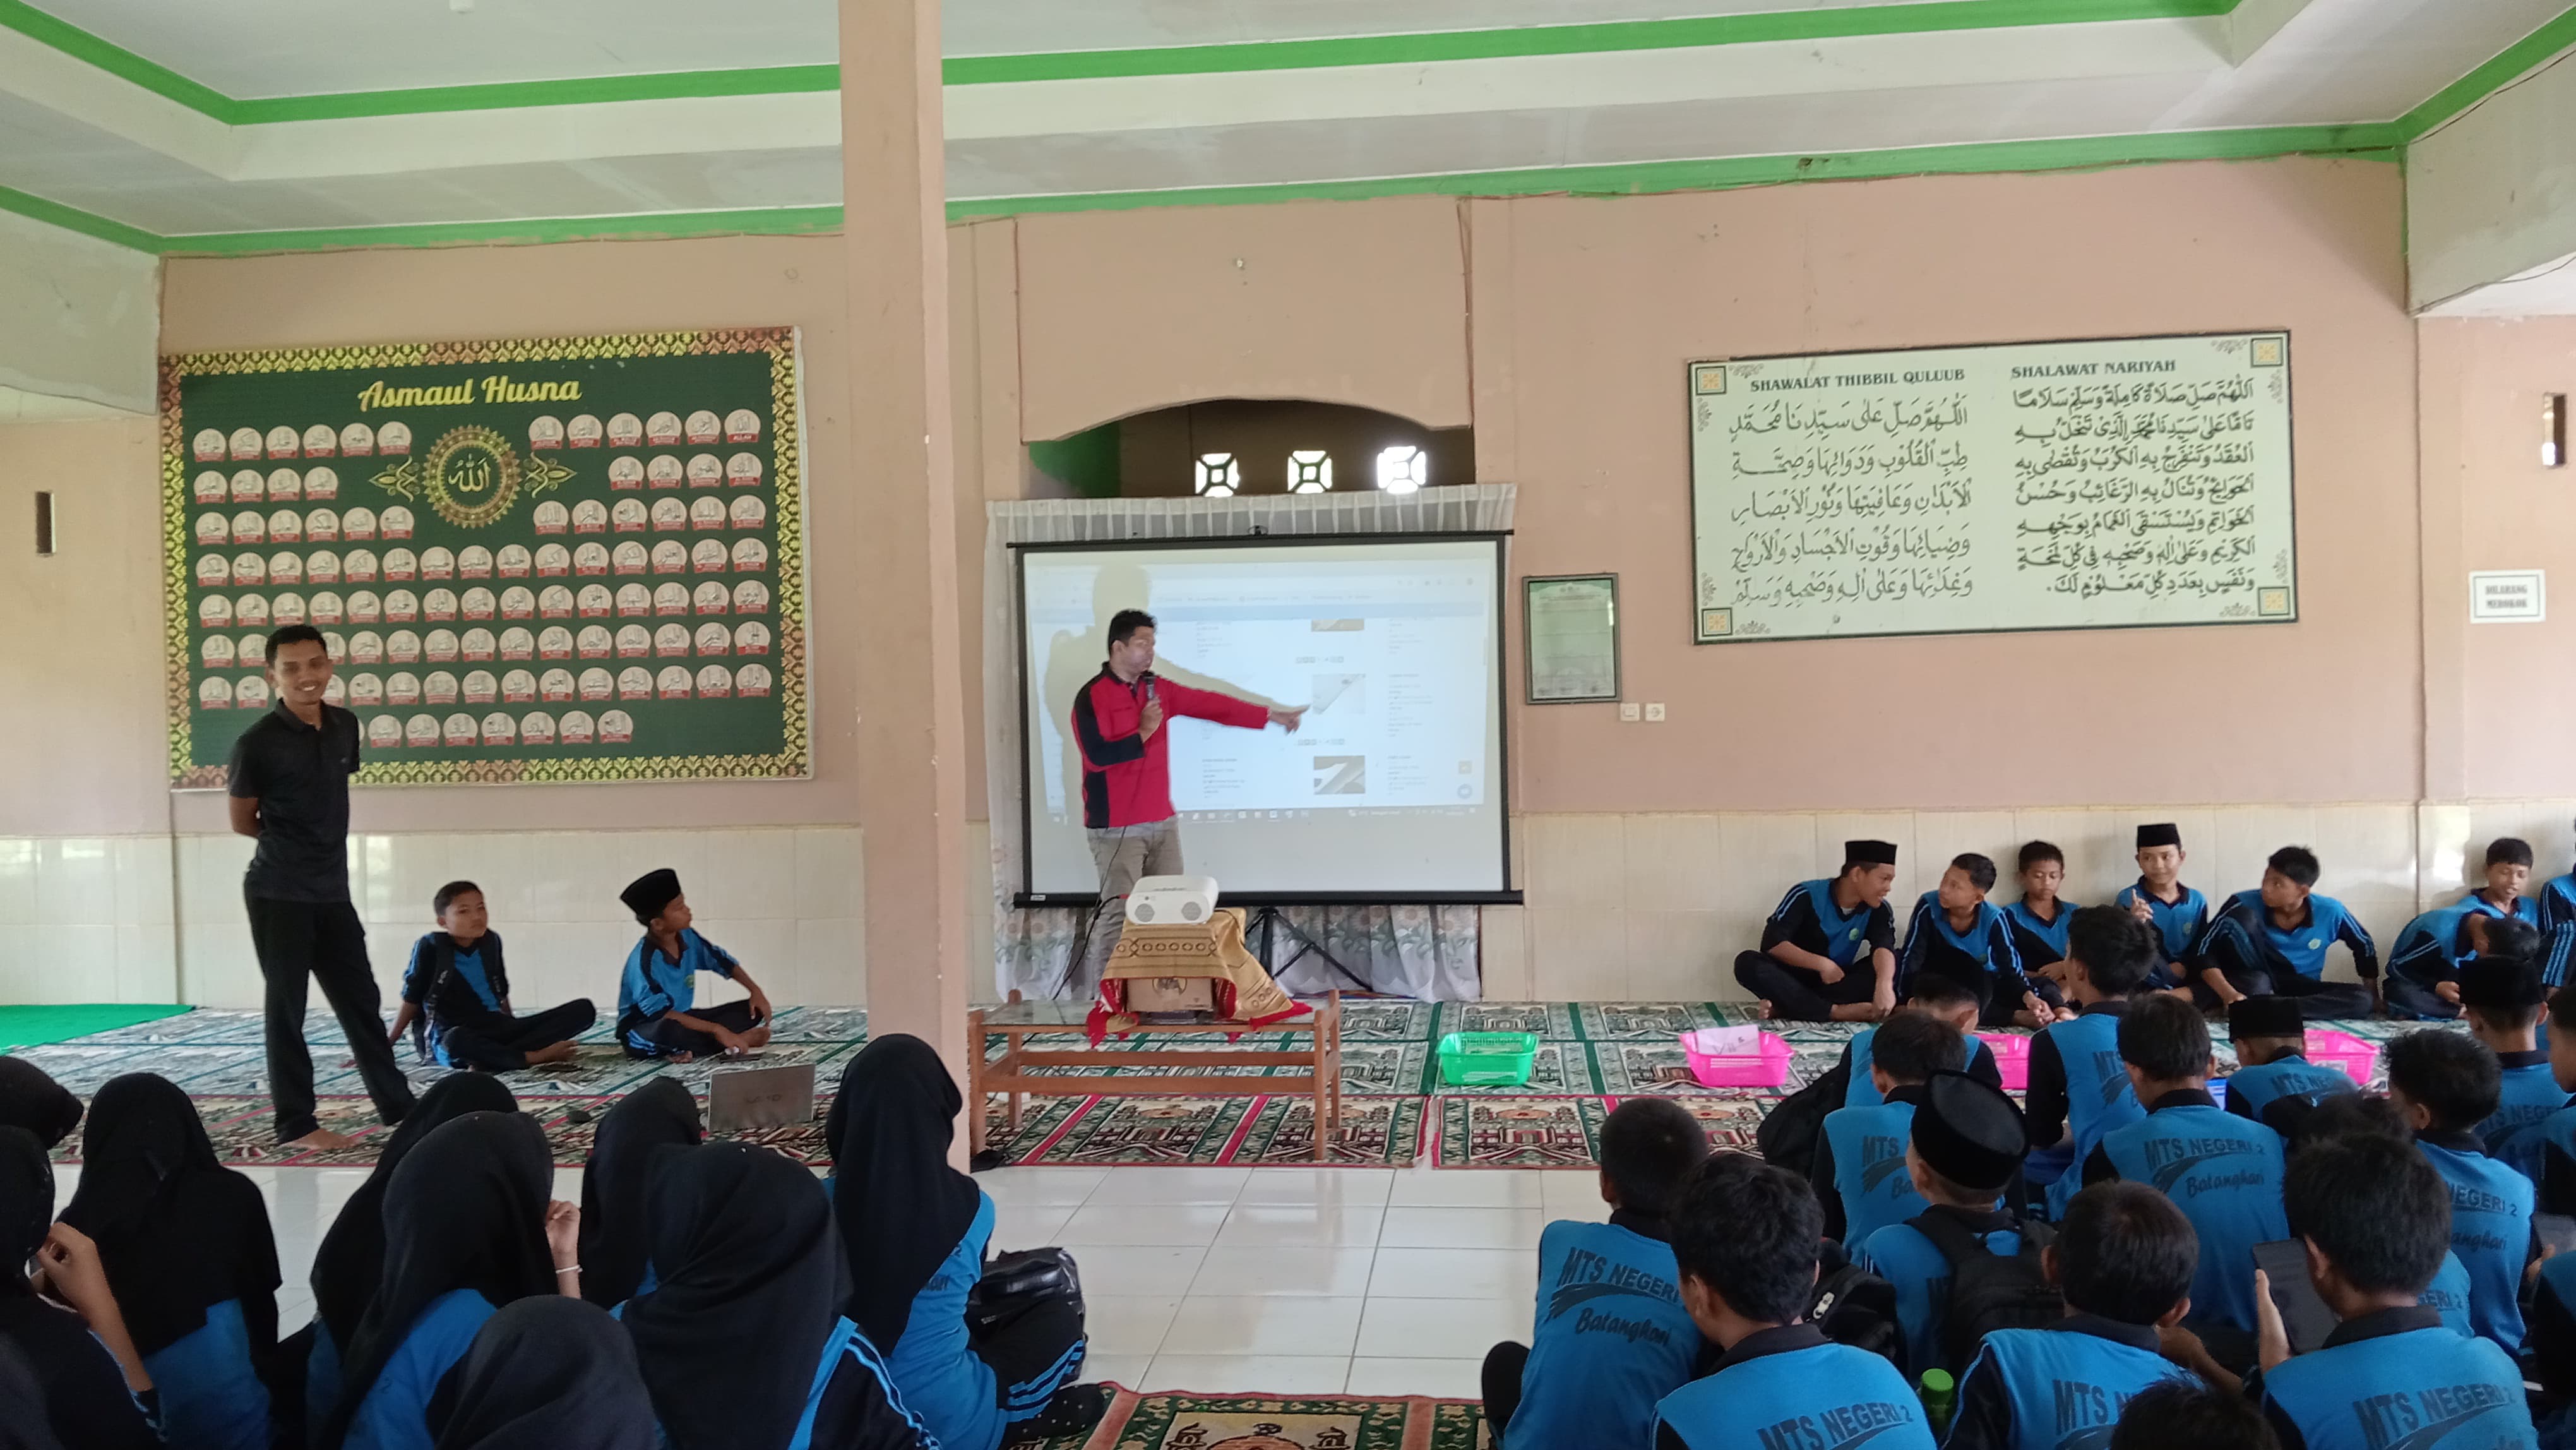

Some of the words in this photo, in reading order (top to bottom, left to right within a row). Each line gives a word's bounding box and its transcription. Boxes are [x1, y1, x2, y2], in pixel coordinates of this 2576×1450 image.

[1751, 376, 1830, 392] SHAWALAT
[1835, 373, 1897, 386] THIBBIL
[1903, 369, 1965, 384] QULUUB
[2011, 363, 2099, 378] SHALAWAT
[2105, 360, 2176, 374] NARIYAH
[357, 378, 475, 412] Asmaul
[480, 374, 583, 404] Husna
[1862, 1135, 1899, 1168] MTS
[2144, 1138, 2184, 1171] MTS
[2188, 1138, 2253, 1156] NEGERI
[2255, 1144, 2267, 1155] 2
[2509, 1203, 2517, 1217] 2
[1556, 1246, 1607, 1288] MTS
[1607, 1262, 1680, 1304] NEGERI
[1819, 1402, 1902, 1445] NEGERI
[1899, 1405, 1914, 1422] 2
[2052, 1379, 2109, 1435] MTS
[2352, 1391, 2420, 1450] MTS
[2417, 1383, 2505, 1422] NEGERI
